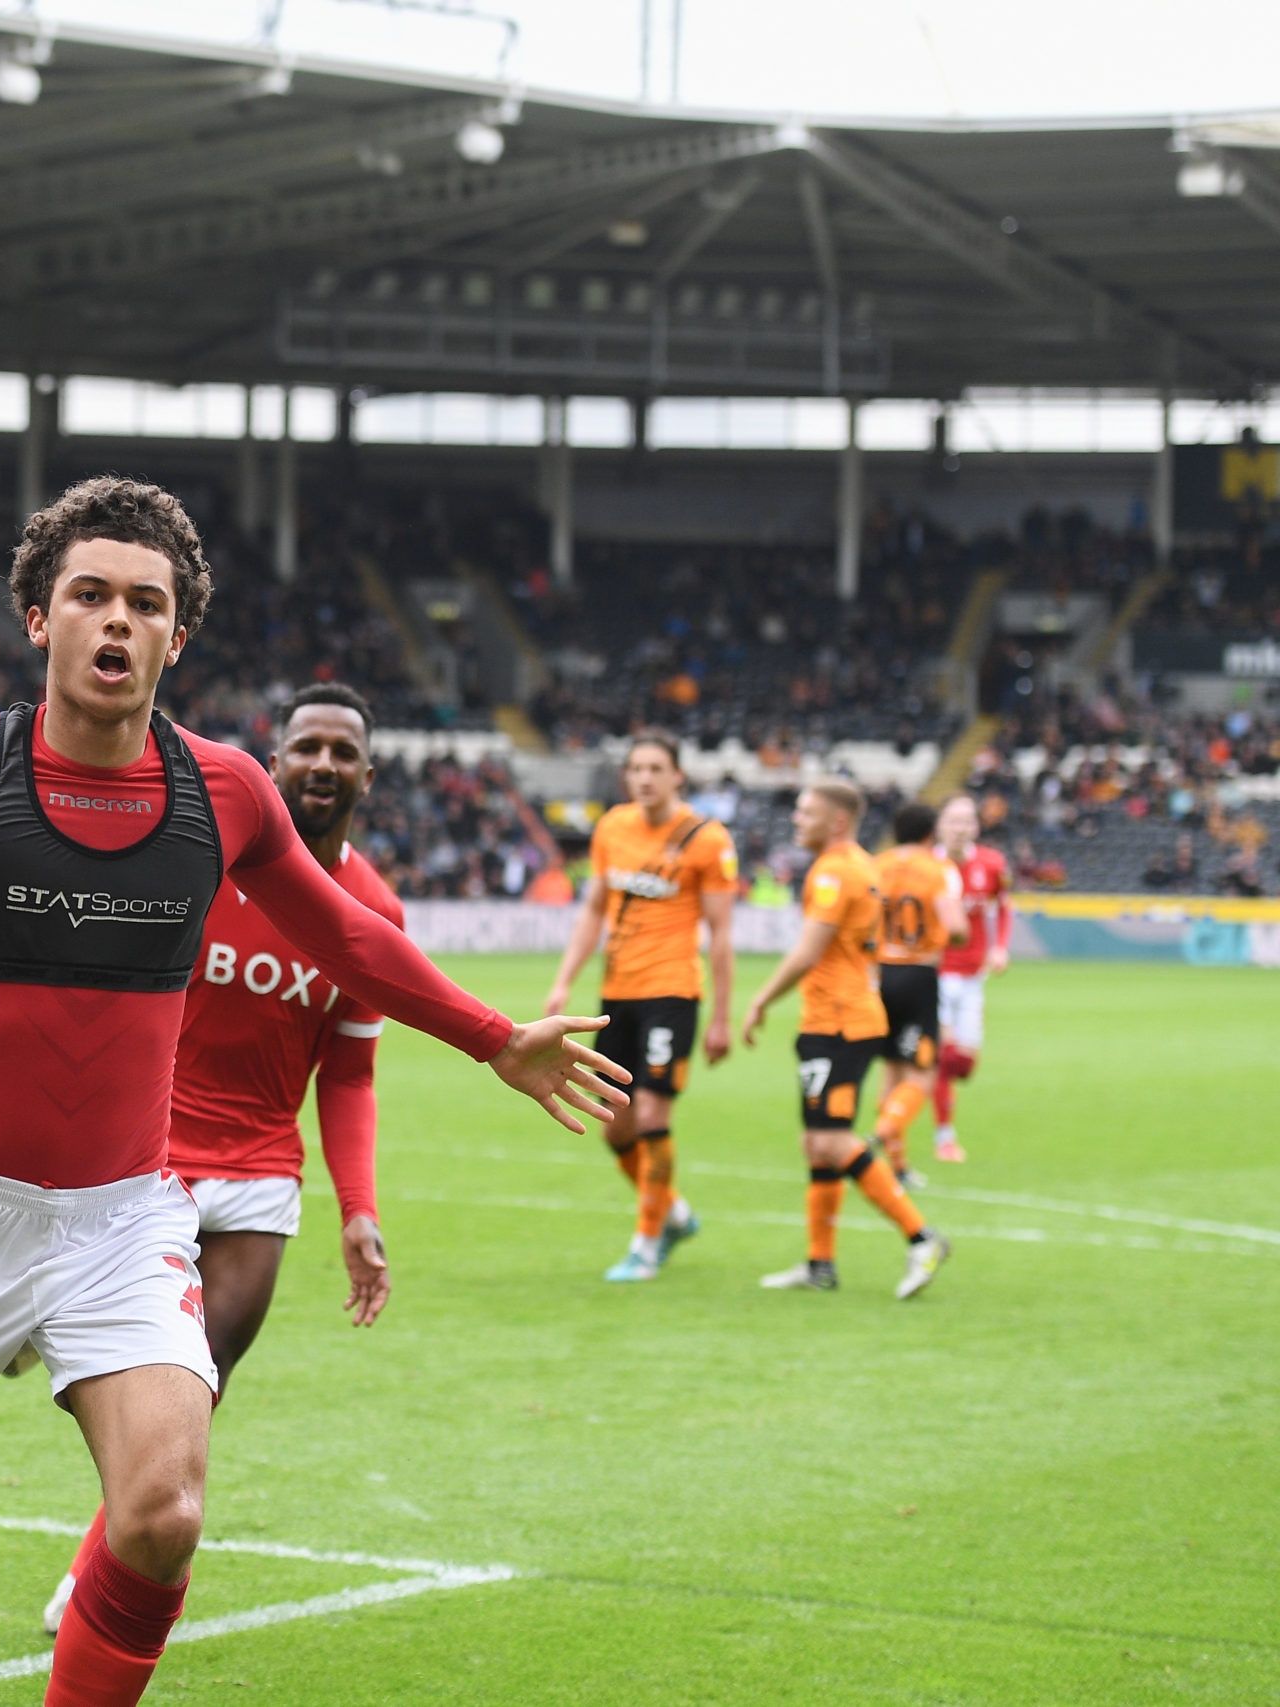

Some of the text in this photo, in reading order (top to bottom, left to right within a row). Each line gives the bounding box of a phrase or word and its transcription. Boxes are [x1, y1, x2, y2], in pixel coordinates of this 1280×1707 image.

[48, 792, 152, 813] macron
[6, 885, 190, 915] STATSports
[646, 1027, 673, 1066] 5
